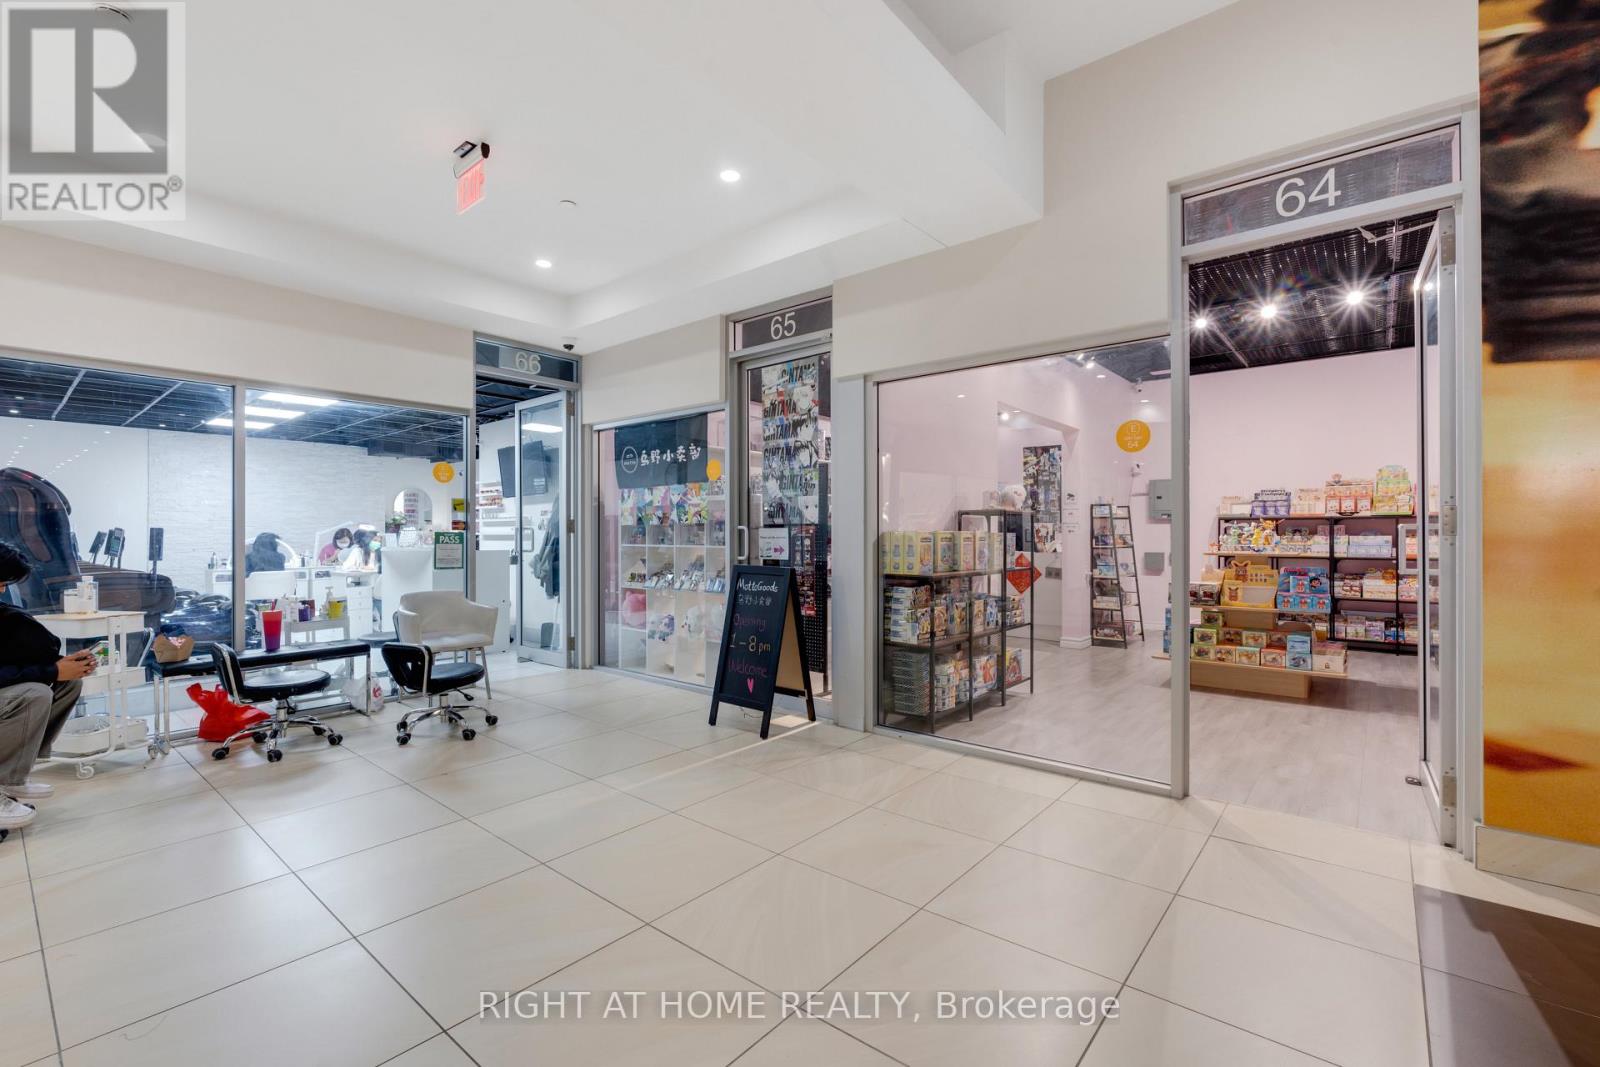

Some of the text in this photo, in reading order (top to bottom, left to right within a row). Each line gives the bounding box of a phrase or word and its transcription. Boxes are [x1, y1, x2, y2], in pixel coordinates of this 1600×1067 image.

[1275, 167, 1342, 217] 64
[770, 311, 796, 340] 65
[515, 351, 542, 375] 66
[439, 535, 460, 544] PASS
